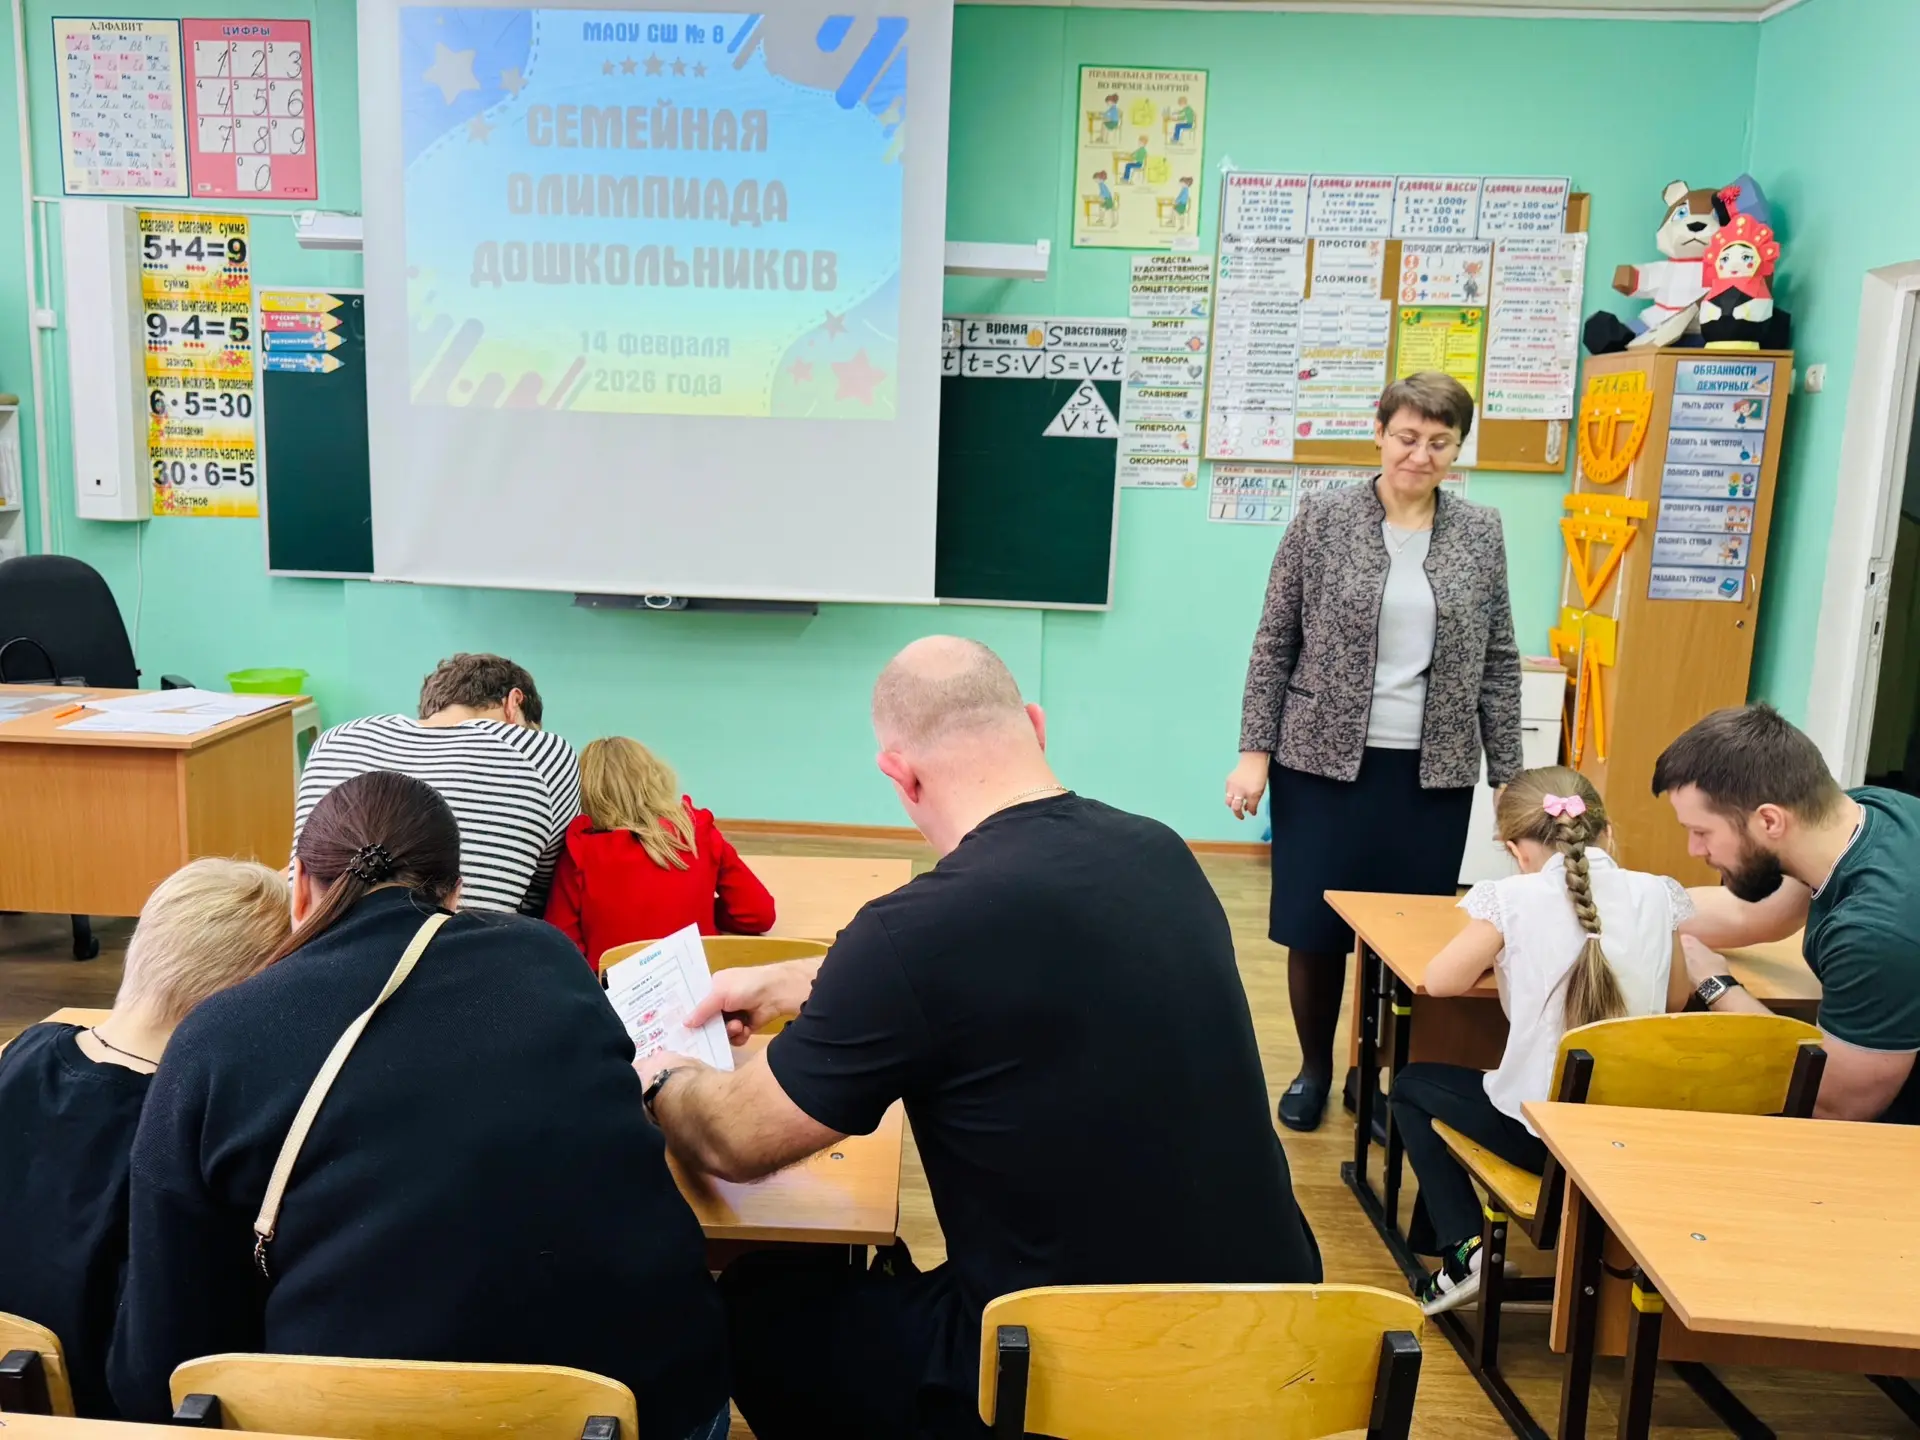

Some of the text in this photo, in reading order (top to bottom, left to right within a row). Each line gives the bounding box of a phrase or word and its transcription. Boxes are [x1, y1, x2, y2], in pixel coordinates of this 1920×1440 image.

[90, 22, 144, 32] АЛФАВИТ
[222, 26, 270, 36] ЦИФРЫ
[583, 21, 724, 44] МАОУ СШ № 8
[195, 41, 303, 79] 1 1 2 2 3 3
[1097, 81, 1190, 92] ВО ВРЕМЯ ЗАНЯТИЙ
[196, 79, 304, 117] 4 4 5 5 6 6
[526, 97, 768, 152] СЕМЕЙНАЯ
[199, 117, 306, 155] 7 7 8 8 9 9
[237, 156, 271, 192] 0 0
[507, 172, 788, 227] ОЛИМПИАДА
[140, 219, 245, 238] слагаемое слагаемое сумма
[143, 234, 247, 263] 5+4=9
[1318, 240, 1368, 248] ПРОСТОЕ
[1403, 243, 1443, 253] ПОРЯДОК
[1444, 242, 1490, 254] ДЕЙСТВИЙ
[470, 240, 838, 292] ДОШКОЛЬНИКОВ
[1151, 256, 1192, 264] СРЕДСТВА
[1134, 264, 1209, 273] ХУДОЖЕСТВЕННОЙ
[1132, 274, 1210, 282] ВЫРАЗИТЕЛЬНОСТИ
[1315, 275, 1368, 283] СЛОЖНОЕ
[164, 279, 189, 291] сумма
[1131, 285, 1208, 294] ОЛИЦЕТВОРЕНИЕ
[144, 299, 249, 316] уменьшаемое вычитаемое разность
[146, 313, 250, 342] 9-4=5
[986, 323, 1028, 337] время
[1152, 321, 1184, 329] ЭПИТЕТ
[1047, 325, 1063, 347] S
[1064, 325, 1128, 338] расстояние
[580, 330, 731, 359] 14 февраля
[166, 358, 194, 369] разность
[1141, 356, 1189, 365] МЕТАФОРА
[1693, 364, 1757, 376] ОБЯЗАННОСТИ
[147, 376, 253, 391] множитель множитель произведение
[594, 368, 722, 396] 2026 года
[1697, 380, 1750, 392] ДЕЖУРНЫХ
[1077, 386, 1093, 406] S
[1138, 390, 1189, 398] СРАВНЕНИЕ
[1487, 391, 1504, 399] НА
[1702, 402, 1725, 410] ДОСКУ
[164, 425, 204, 437] произведение
[1135, 424, 1187, 432] ГИПЕРБОЛА
[1670, 438, 1698, 446] СЛЕДИТЬ
[1709, 438, 1743, 447] ЧИСТОТОЙ
[150, 446, 255, 460] делимое делитель частное
[1129, 457, 1189, 465] ОКСЮМОРОН
[1666, 468, 1724, 477] ПОЛИВАТЬ ЦВЕТЫ
[174, 495, 208, 507] частное
[1664, 503, 1724, 513] ПРОВЕРИТЬ РЕБЯТ
[1657, 537, 1713, 546] ПОДНЯТЬ СТУЛЬЯ
[1652, 574, 1716, 583] РАЗДАВАТЬ ТЕТРАДИ
